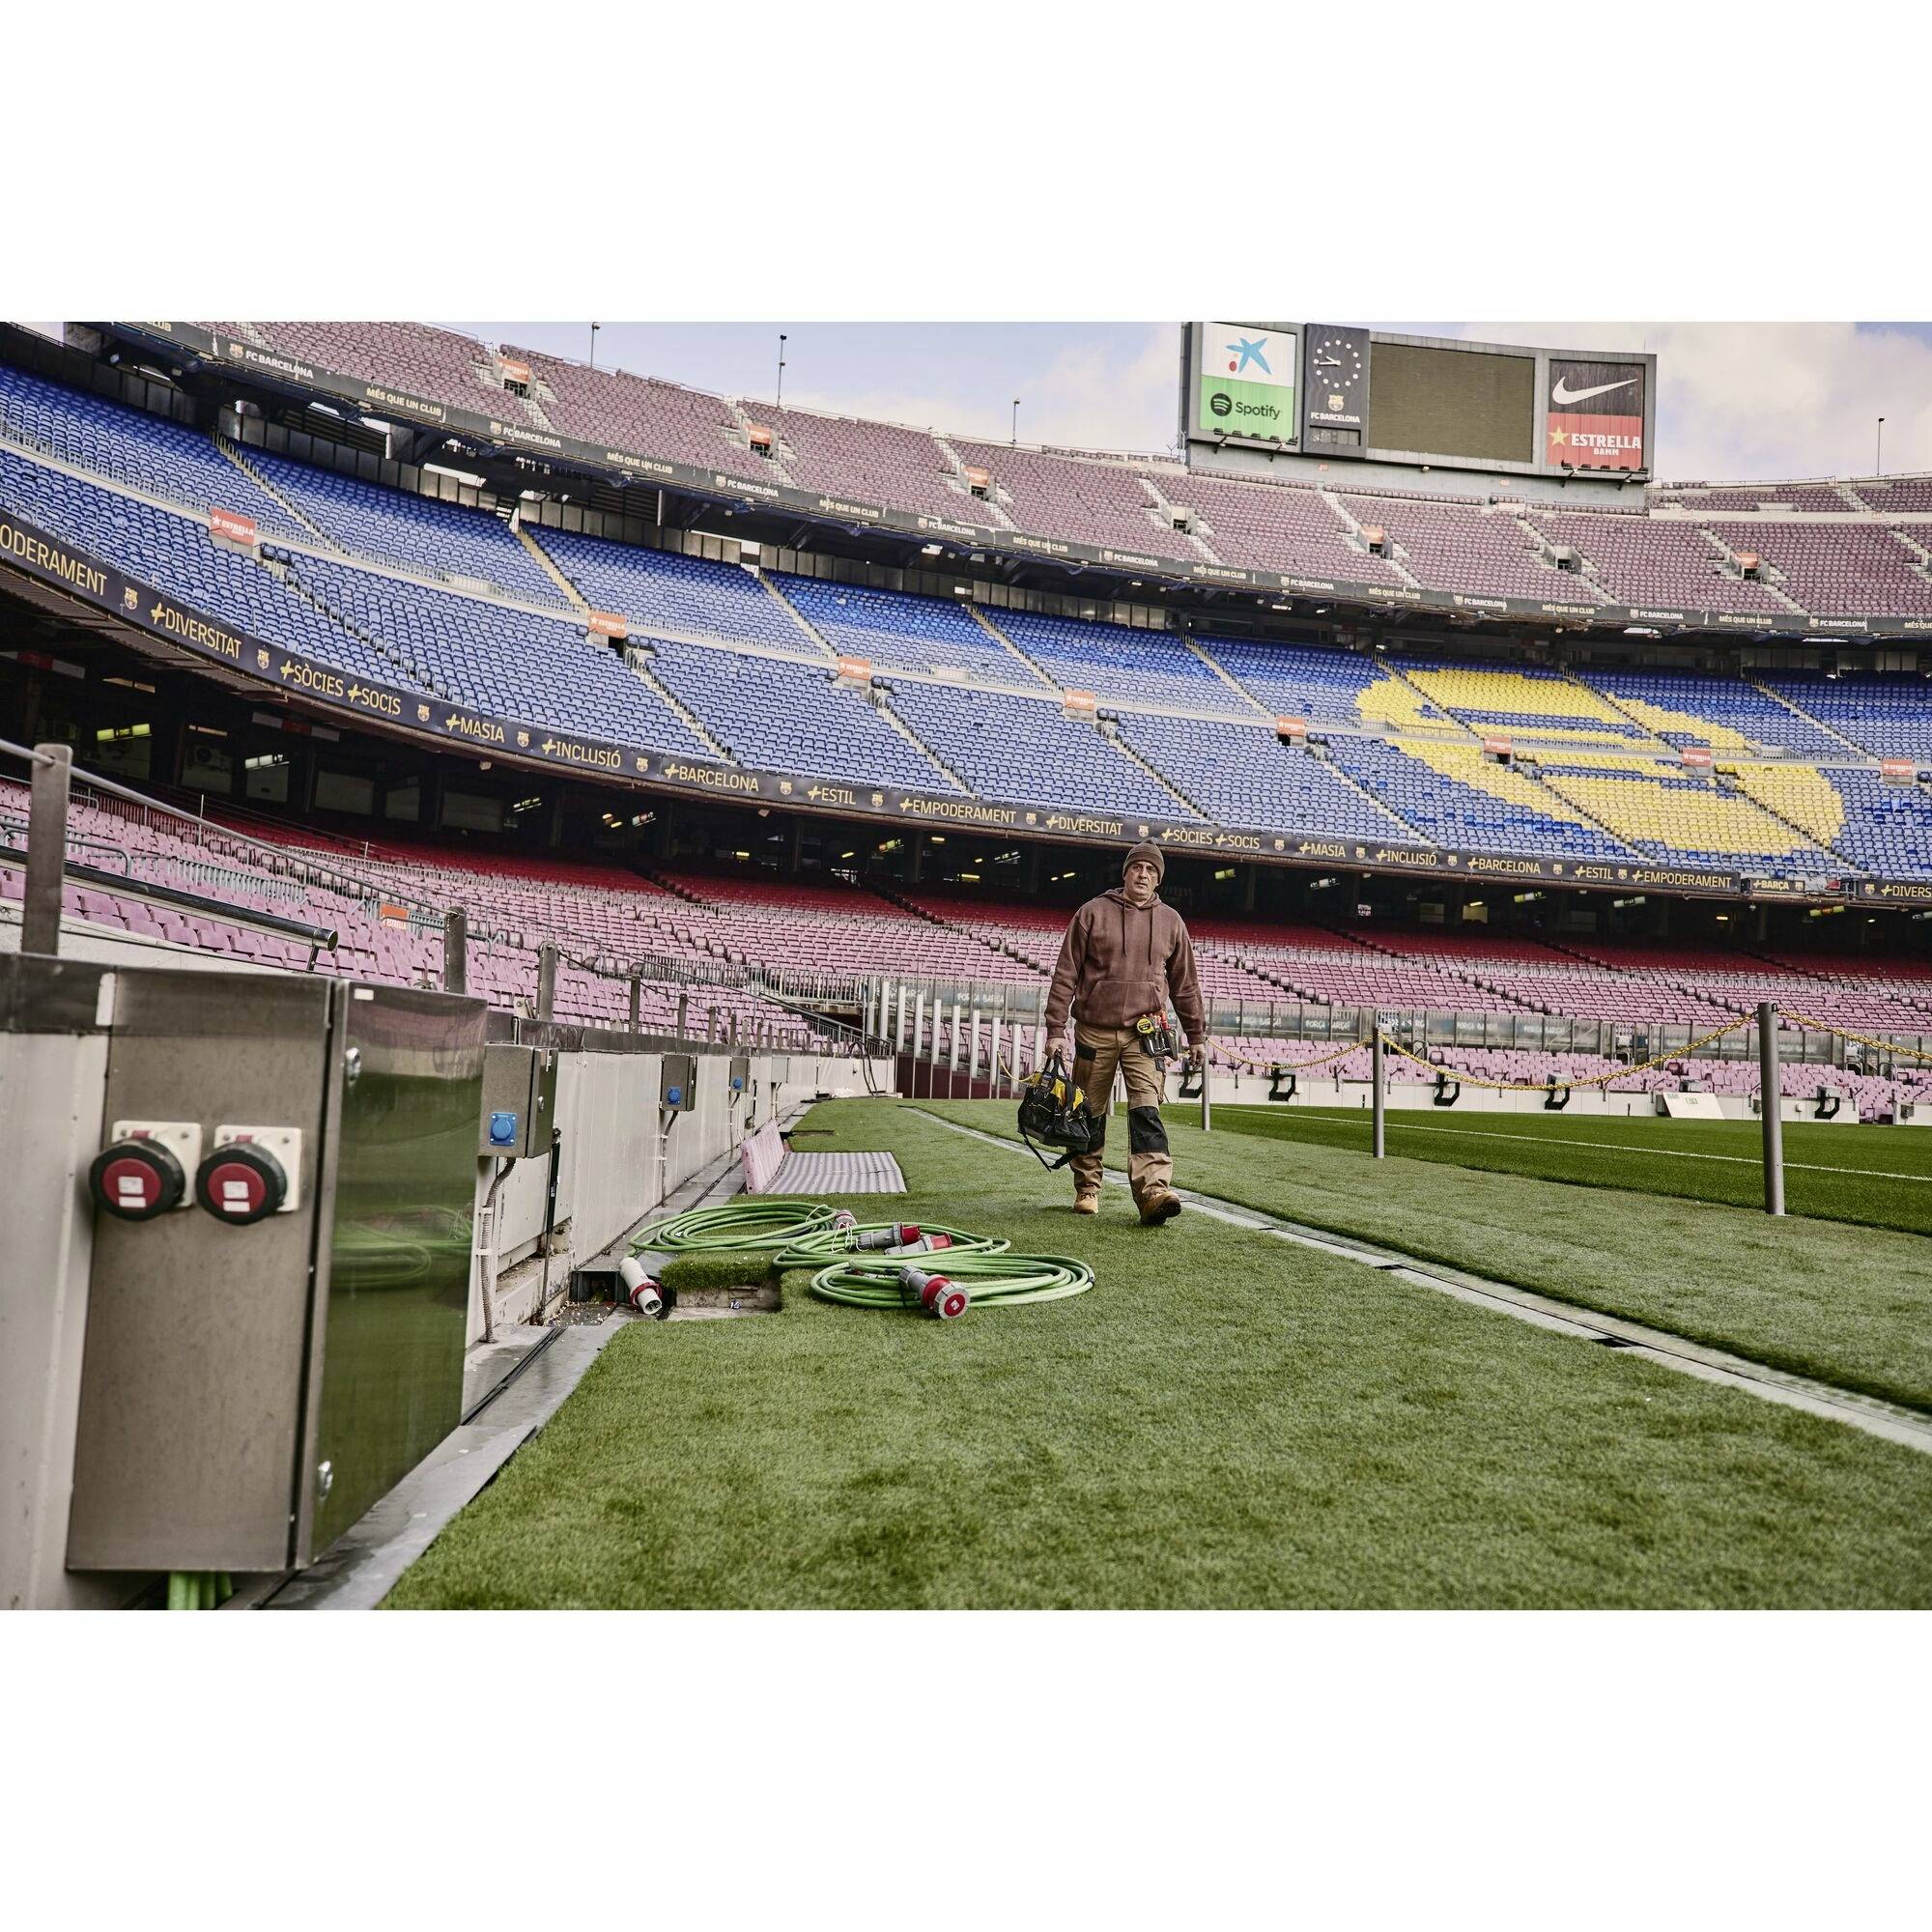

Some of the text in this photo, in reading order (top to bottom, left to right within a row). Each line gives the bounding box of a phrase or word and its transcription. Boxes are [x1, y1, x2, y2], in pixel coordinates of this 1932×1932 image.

[245, 351, 314, 379] FC BARCELONA
[366, 387, 441, 416] MÉS QUE UN CLUB
[1236, 402, 1281, 421] Spotify
[1310, 412, 1361, 423] FC BARCELONA
[503, 427, 561, 448] FC BARCELONA
[1571, 433, 1642, 449] ESTRELLA
[607, 451, 673, 474] MÉS QUE UN CLUB
[727, 479, 736, 489] FC
[0, 525, 107, 596] ODERAMENT
[1382, 588, 1395, 597] QUE
[1405, 590, 1421, 600] CLUB
[1555, 605, 1569, 613] QUE
[1578, 606, 1595, 615] CLUB
